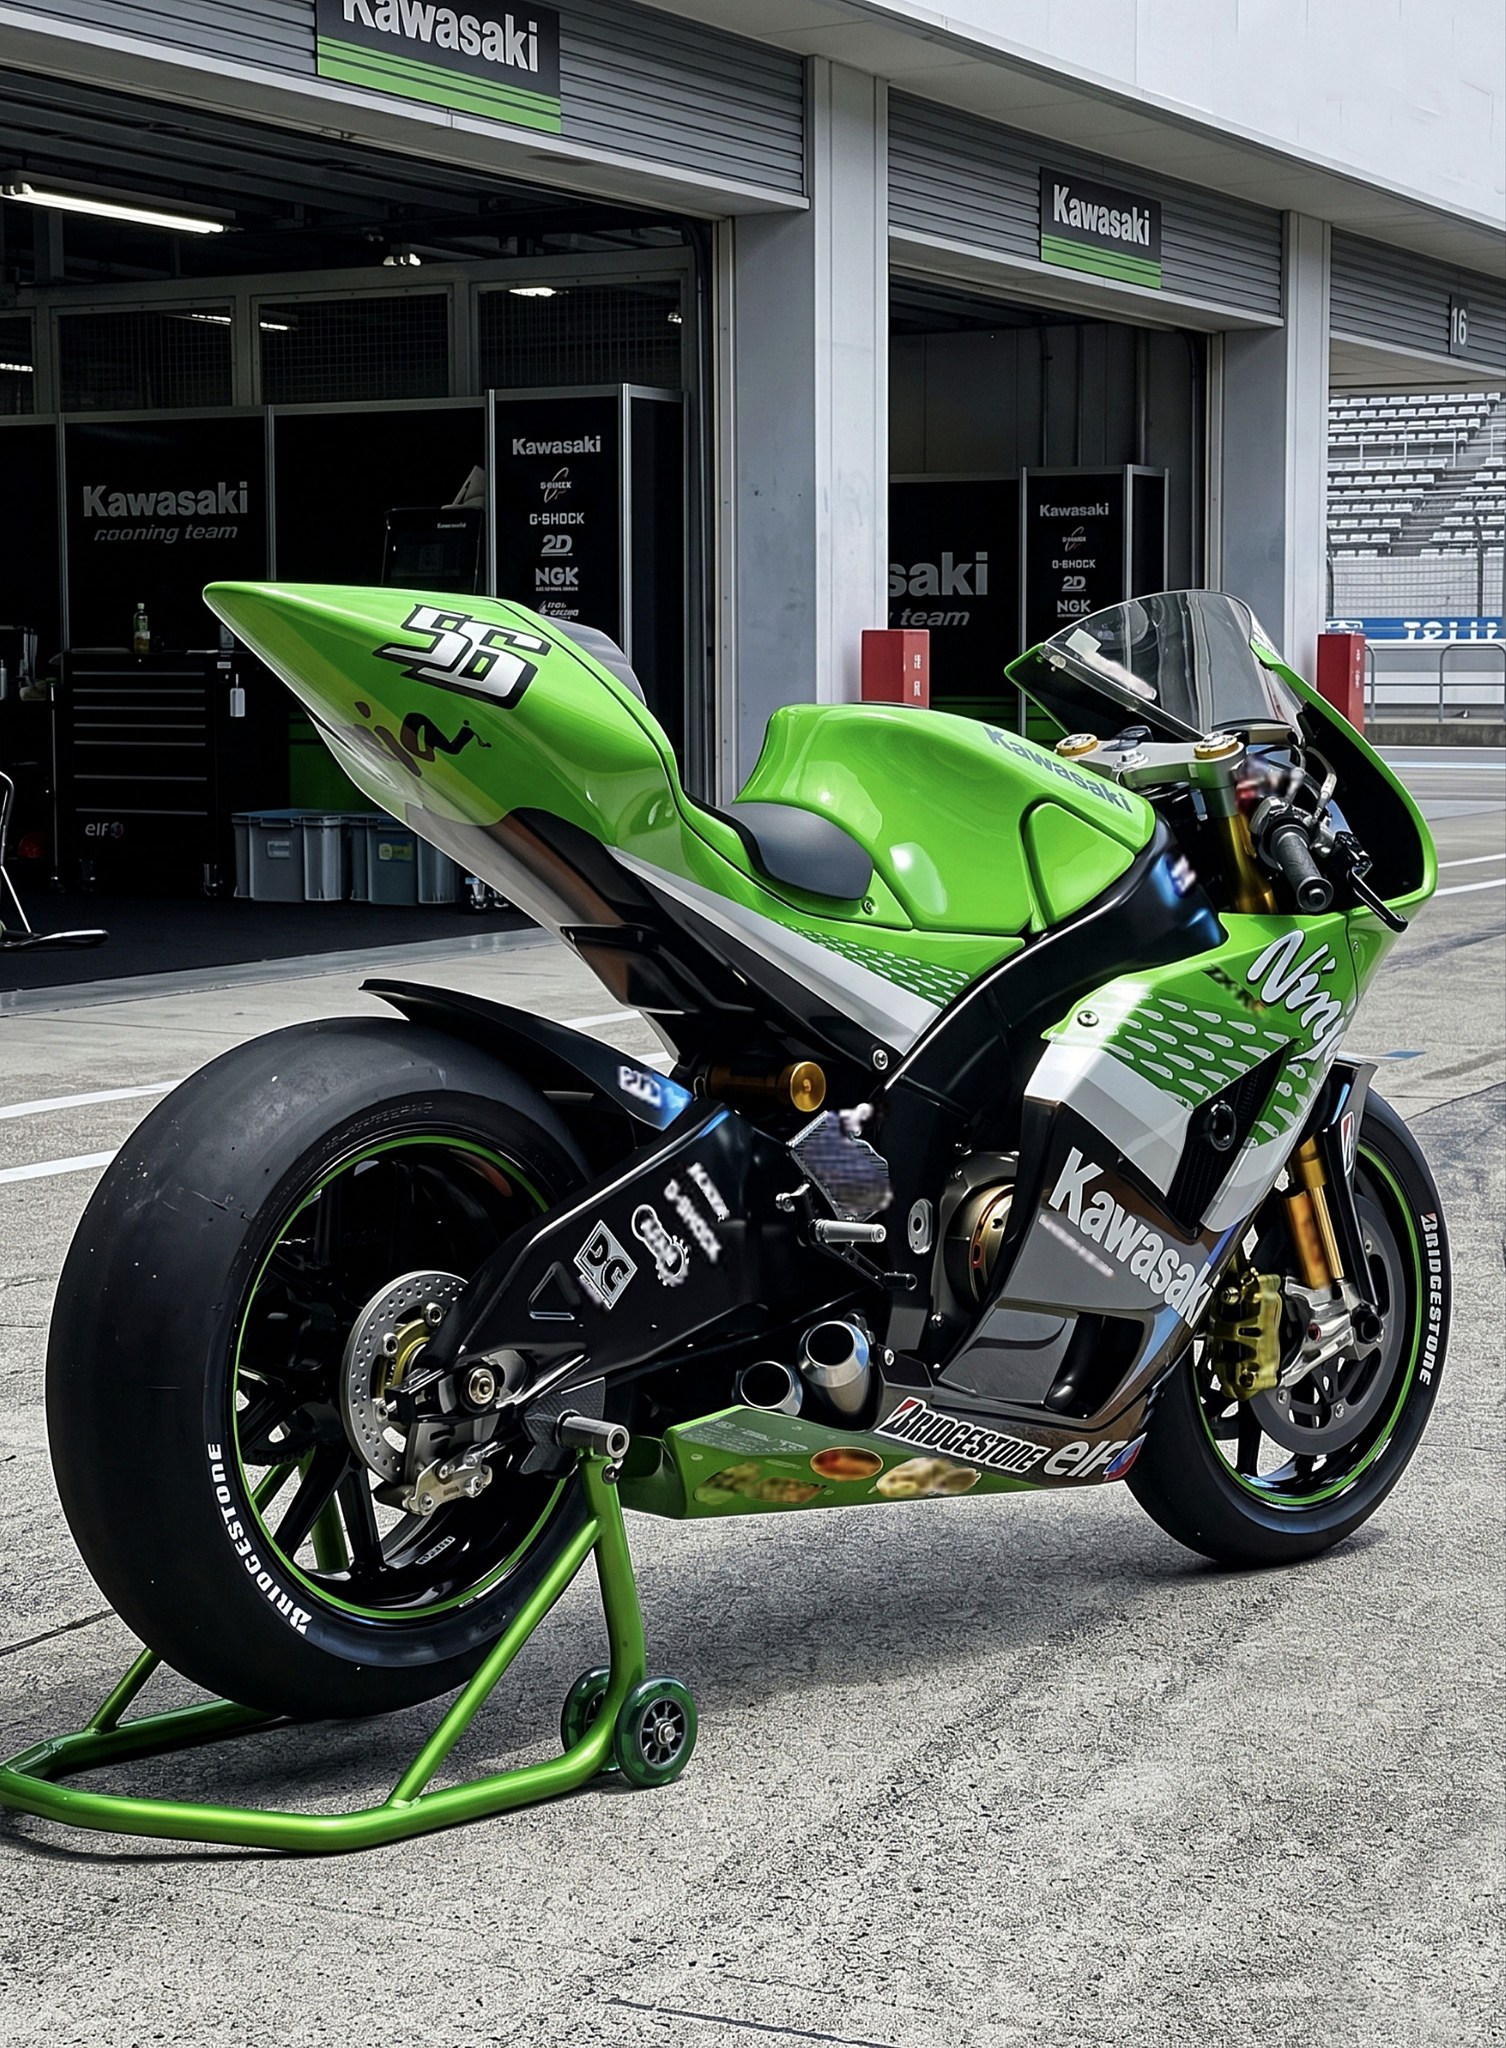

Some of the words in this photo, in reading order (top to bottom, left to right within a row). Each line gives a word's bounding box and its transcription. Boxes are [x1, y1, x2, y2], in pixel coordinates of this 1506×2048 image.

[1053, 183, 1150, 246] Kawasaki
[1451, 307, 1467, 345] 16
[512, 435, 601, 455] Kawasaki
[83, 481, 248, 517] Kawasaki
[1040, 502, 1109, 517] Kawasaki
[185, 524, 238, 539] team
[541, 534, 573, 554] 2D
[535, 567, 579, 586] NGK
[1062, 575, 1086, 590] 2D
[900, 608, 970, 626] team
[1056, 599, 1091, 613] NGK
[374, 604, 551, 709] 56
[983, 726, 1133, 813] Kawasaki
[85, 822, 109, 836] elf
[1048, 1146, 1220, 1329] Kawasaki
[1420, 1212, 1442, 1386] BRIDGESTONE
[878, 1398, 1049, 1472] BRIDGESTONE
[1044, 1440, 1128, 1477] elf
[207, 1443, 313, 1635] BRIDGESTONE
